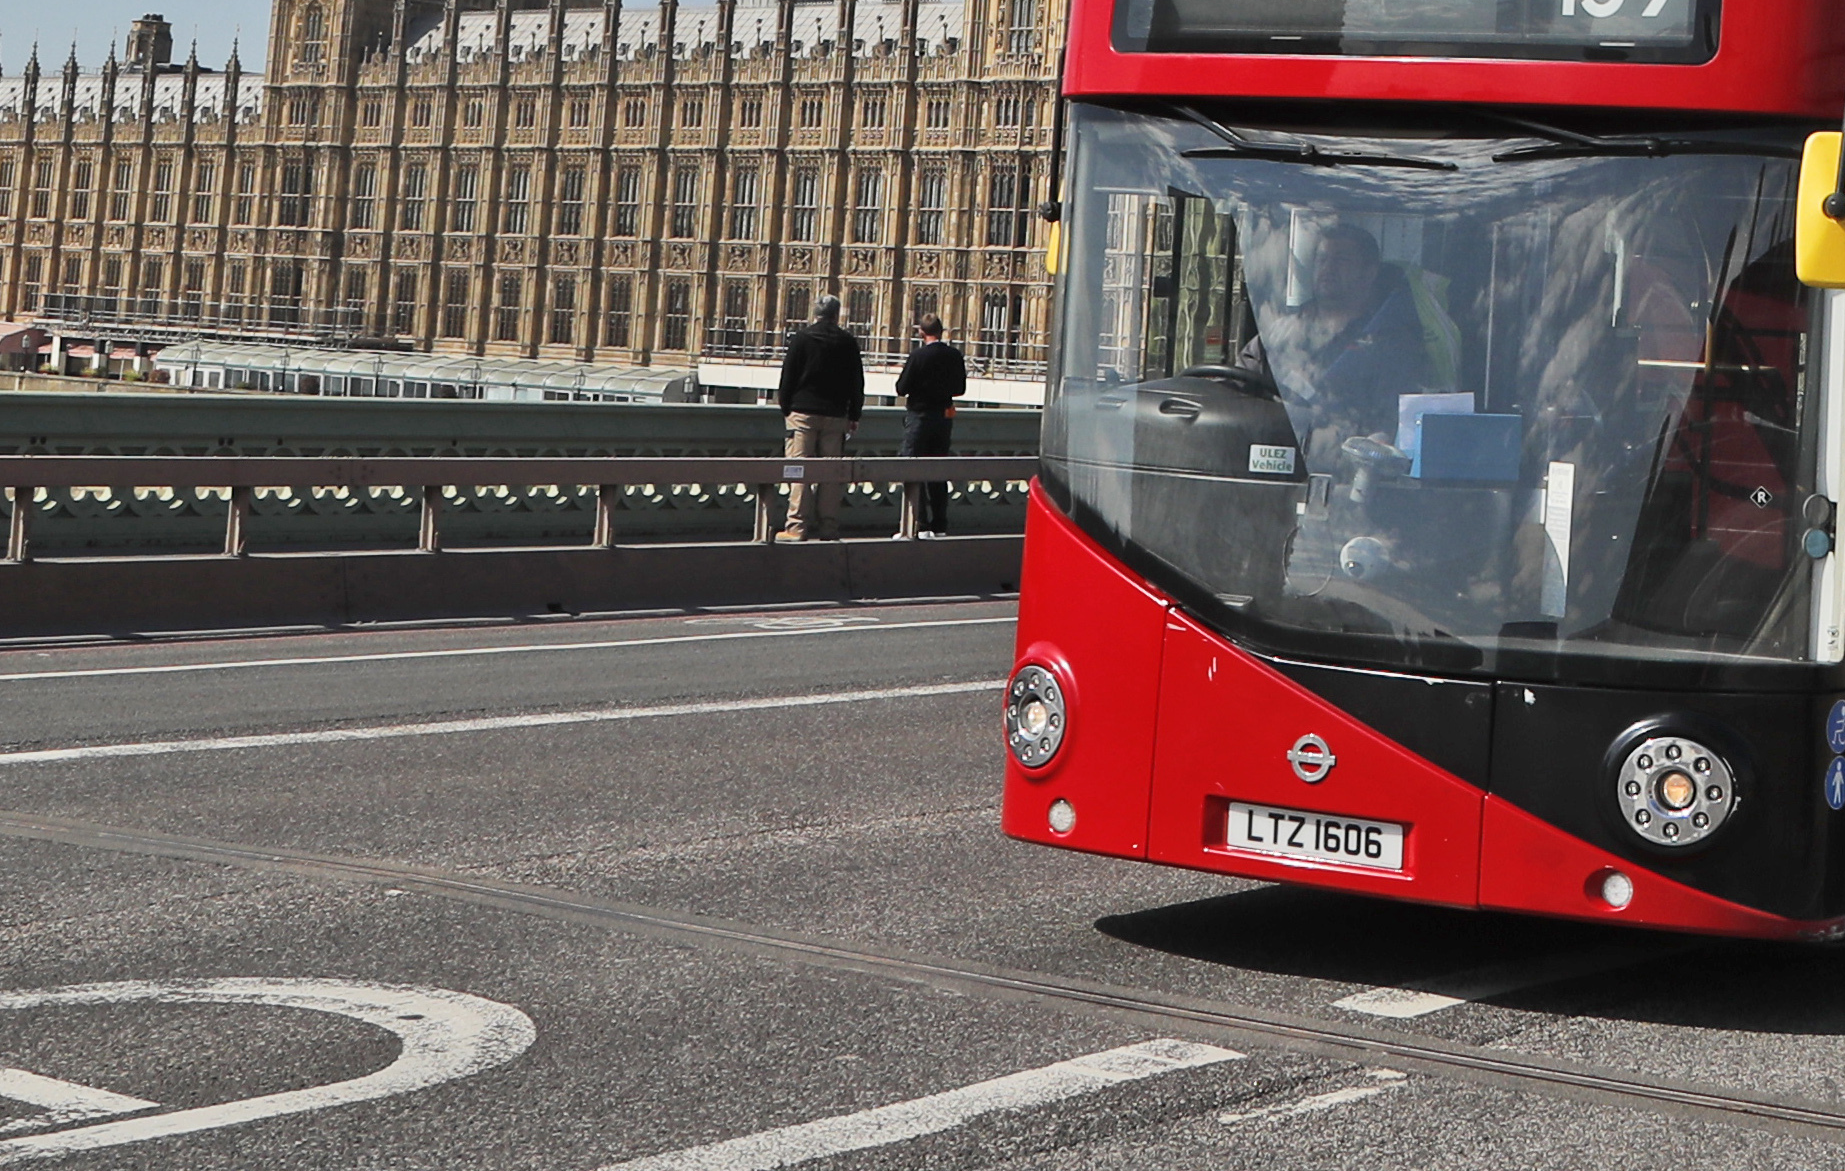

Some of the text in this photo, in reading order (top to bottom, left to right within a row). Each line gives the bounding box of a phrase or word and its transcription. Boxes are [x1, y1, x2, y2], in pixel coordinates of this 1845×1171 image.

[1260, 447, 1288, 459] ULEZ
[1252, 459, 1293, 472] Vehicle
[1758, 491, 1766, 503] R
[1247, 809, 1382, 859] LTZ 1606
